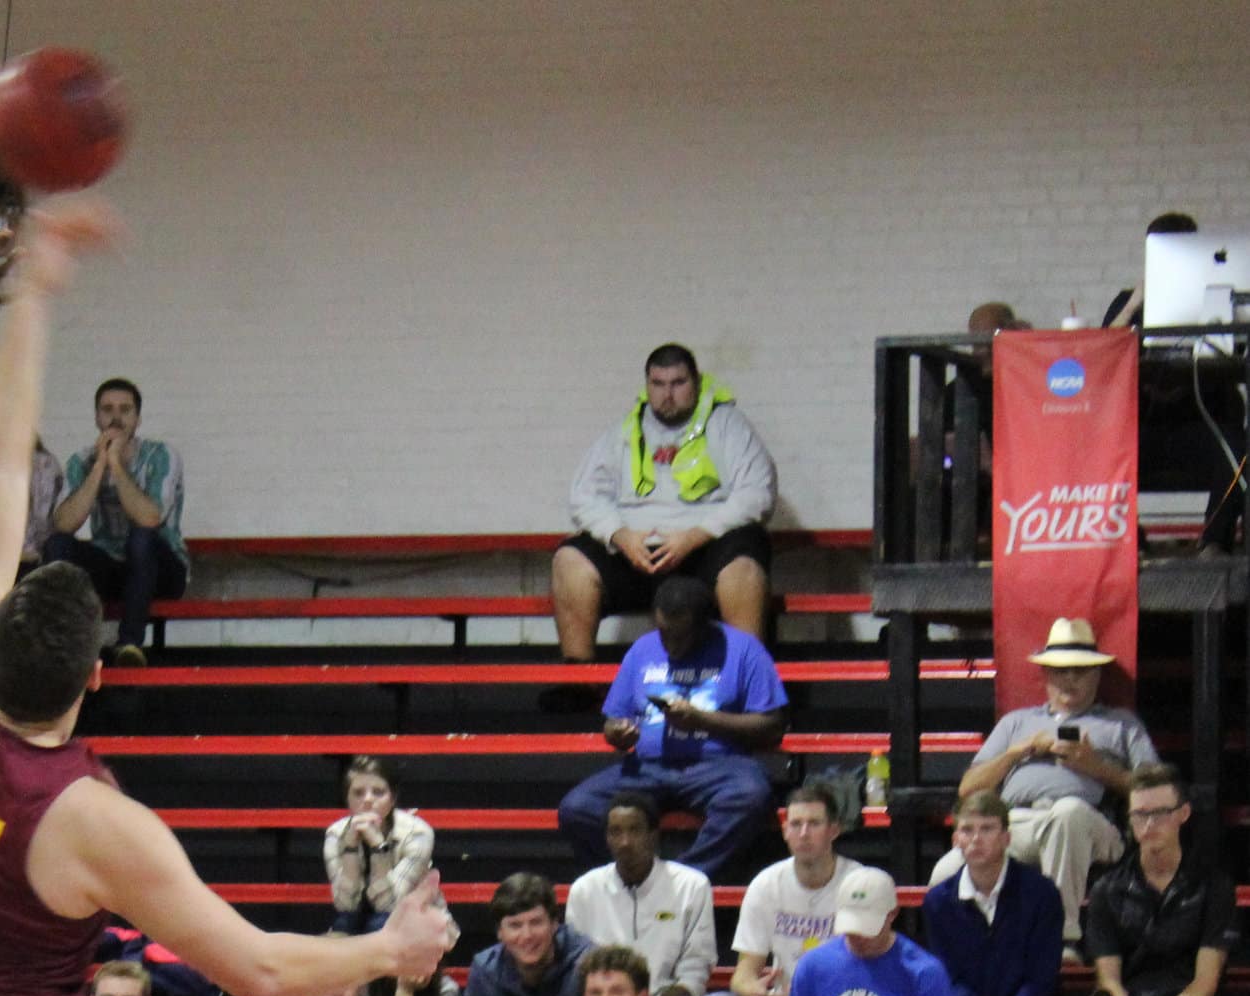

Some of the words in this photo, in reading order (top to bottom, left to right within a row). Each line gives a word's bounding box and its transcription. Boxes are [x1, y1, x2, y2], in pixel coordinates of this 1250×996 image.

[1050, 485, 1108, 504] MAKE
[1111, 483, 1132, 501] IT
[1000, 492, 1129, 556] YOURS
